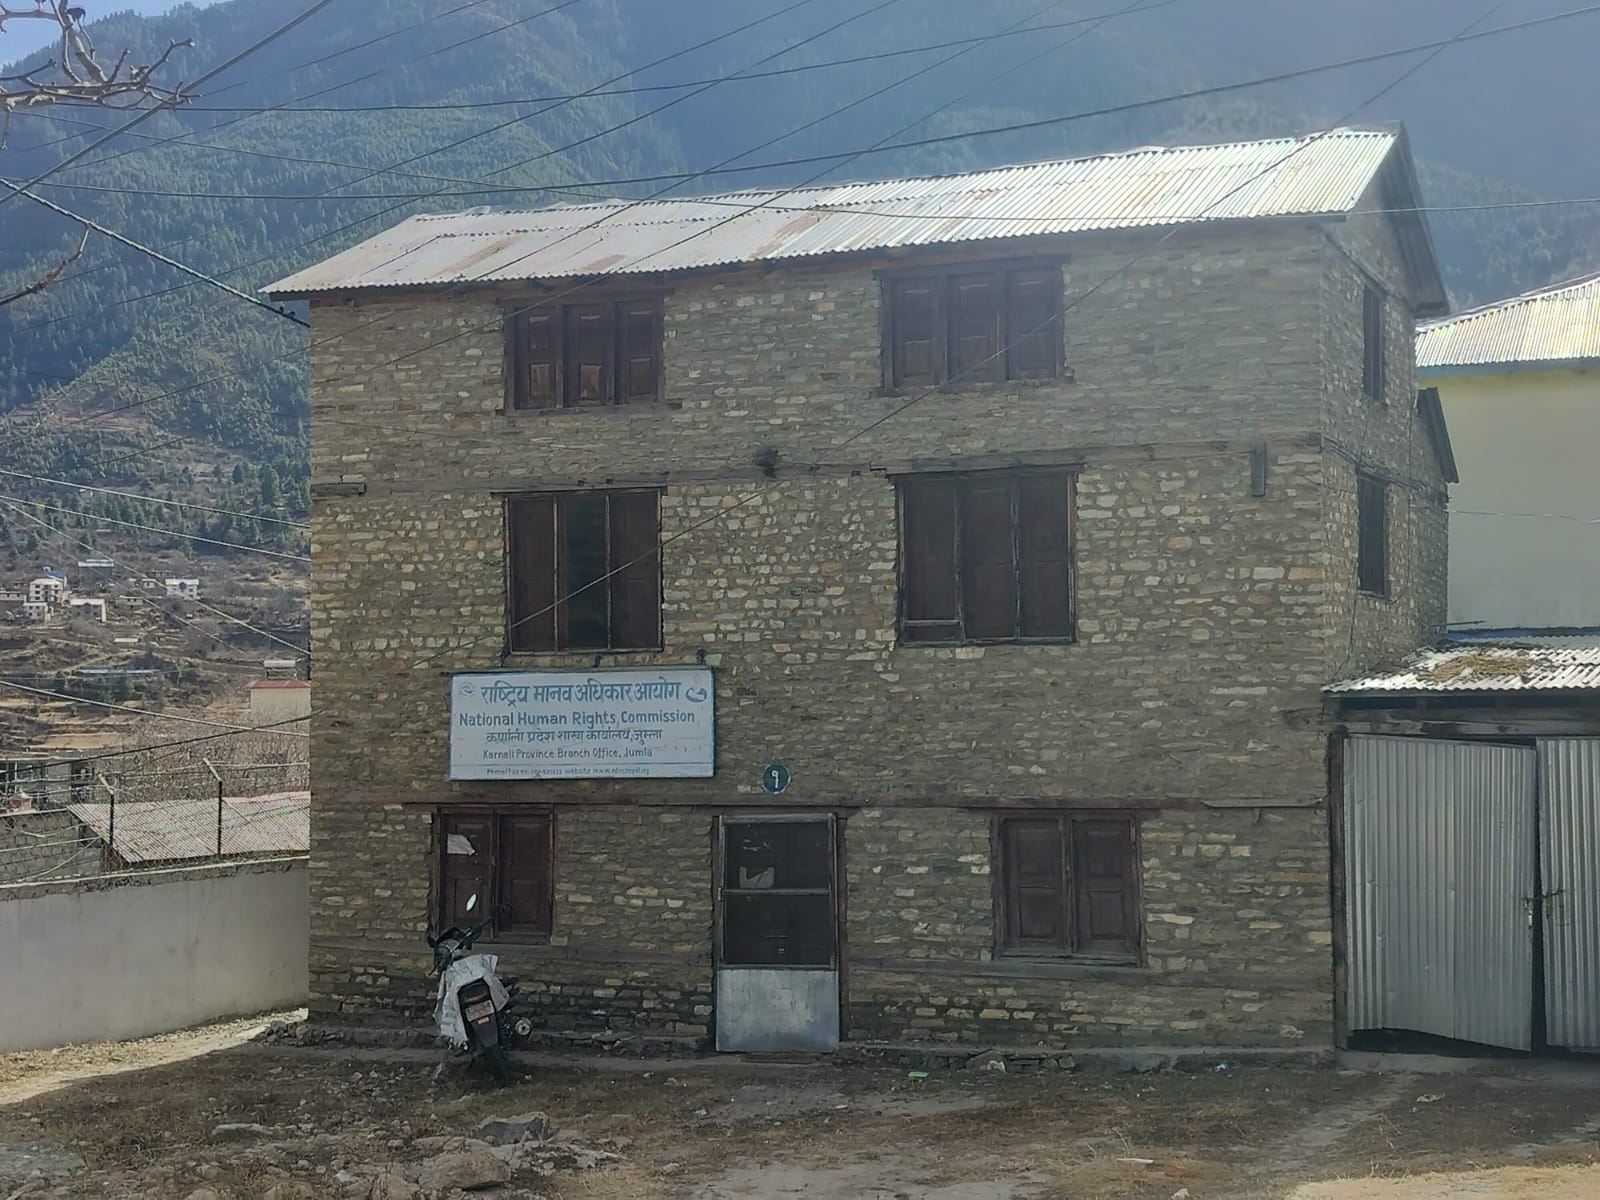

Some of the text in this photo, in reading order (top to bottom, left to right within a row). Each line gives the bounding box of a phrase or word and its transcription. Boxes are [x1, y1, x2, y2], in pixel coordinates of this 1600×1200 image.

[534, 685, 574, 703] मानव
[575, 678, 633, 703] अधिकार
[634, 676, 682, 701] आयोग
[459, 709, 695, 729] National Human Rights Commission
[527, 728, 555, 742] प्रदेश
[558, 730, 584, 741] शाखा
[483, 749, 514, 759] Karnali
[516, 748, 555, 759] Province
[557, 747, 590, 758] Branch
[624, 746, 653, 757] Jumla
